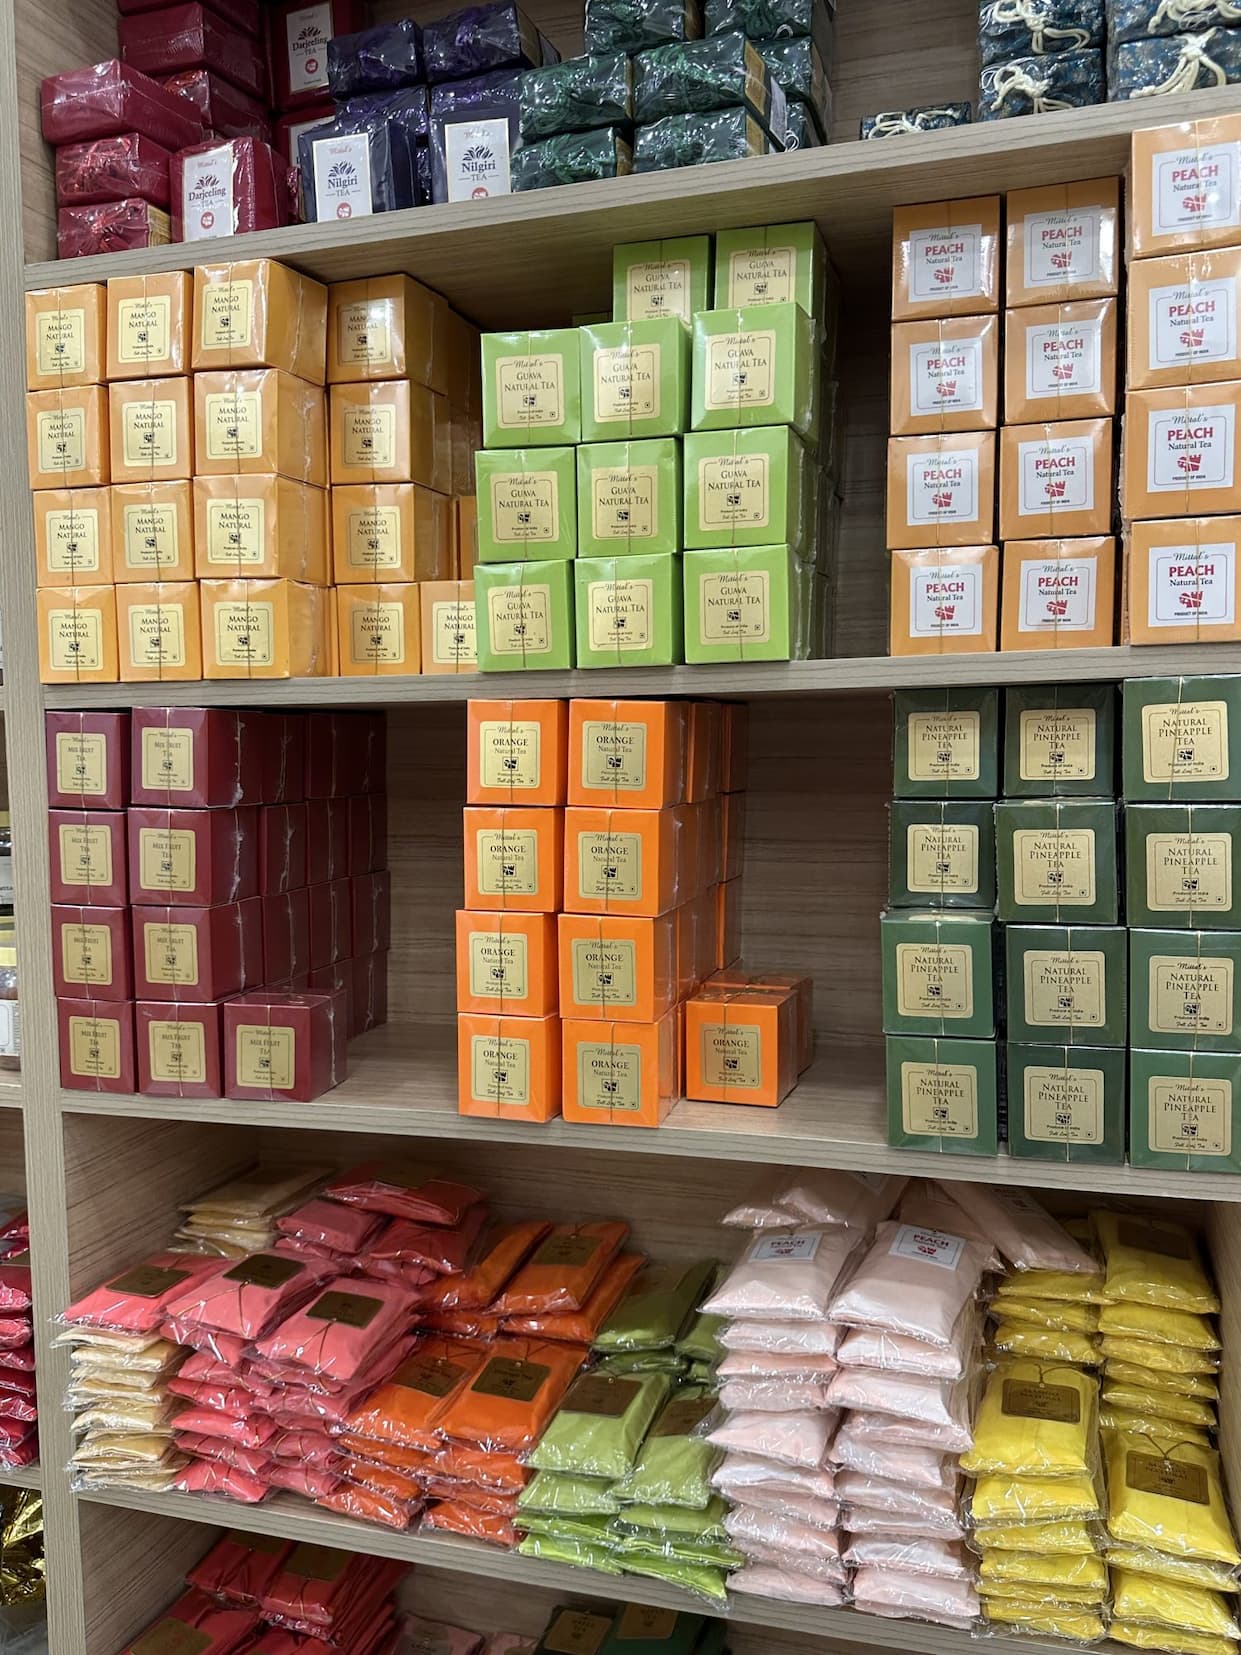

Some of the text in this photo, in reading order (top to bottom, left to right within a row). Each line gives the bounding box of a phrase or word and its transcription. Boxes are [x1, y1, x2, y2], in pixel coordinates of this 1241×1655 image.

[462, 160, 496, 173] Nilgiri
[471, 173, 487, 182] TEA
[1172, 165, 1218, 181] PEACH
[328, 175, 358, 189] Nilgiri
[189, 186, 226, 202] Darjeeling
[1041, 226, 1082, 240] PEACH
[925, 243, 964, 256] PEACH
[926, 255, 963, 264] Natural Tea
[749, 260, 774, 269] GUAVA
[737, 269, 787, 280] NATURAL TEA
[634, 281, 681, 293] NATURAL TEA
[1169, 301, 1215, 316] PEACH
[1201, 314, 1214, 323] Tea
[1043, 338, 1084, 352] PEACH
[1070, 350, 1082, 358] Tea
[752, 358, 767, 367] TEA
[927, 356, 965, 369] PEACH
[517, 371, 541, 381] GUAVA
[928, 368, 964, 377] Natural Tea
[601, 371, 650, 384] NATURAL TEA
[540, 380, 555, 389] TEA
[354, 417, 381, 426] MANGO
[353, 426, 383, 435] NATURAL
[1167, 427, 1213, 441] PEACH
[1168, 440, 1211, 450] Natural Tea
[1035, 457, 1075, 470] PEACH
[721, 469, 747, 479] GUAVA
[923, 469, 962, 480] PEACH
[1037, 469, 1074, 478] Natural Tea
[746, 479, 760, 488] TEA
[924, 479, 961, 489] Natural Tea
[511, 489, 536, 498] GUAVA
[611, 486, 636, 495] GUAVA
[499, 498, 549, 508] NATURAL TEA
[599, 495, 649, 505] NATURAL TEA
[221, 513, 249, 521] MANGO
[137, 518, 163, 526] MANGO
[219, 521, 251, 529] NATURAL
[360, 519, 387, 528] MANGO
[136, 526, 166, 534] NATURAL
[358, 528, 389, 536] NATURAL
[1169, 565, 1214, 577] PEACH
[1038, 576, 1078, 588] PEACH
[1170, 577, 1213, 587] Natural Tea
[720, 586, 747, 596] GUAVA
[926, 582, 965, 593] PEACH
[1038, 587, 1077, 596] Natural Tea
[608, 594, 632, 603] GUAVA
[708, 595, 760, 606] NATURAL TEA
[927, 593, 963, 602] Natural Tea
[507, 602, 531, 610] GUAVA
[596, 604, 645, 614] NATURAL TEA
[229, 615, 258, 624] MANGO
[362, 616, 390, 624] MANGO
[446, 614, 473, 622] MANGO
[496, 611, 544, 620] NATURAL TEA
[227, 624, 260, 632] NATURAL
[361, 624, 391, 633] NATURAL
[444, 623, 475, 632] NATURAL
[59, 630, 90, 638] NATURAL
[1163, 719, 1207, 728] NATURAL
[926, 725, 964, 733] NATURAL
[1037, 724, 1077, 733] NATURAL
[1159, 727, 1212, 737] PINEAPPLE
[596, 736, 634, 744] ORANGE
[922, 733, 968, 741] PINEAPPLE
[1033, 733, 1080, 741] PINEAPPLE
[1177, 737, 1195, 746] TEA
[490, 845, 526, 853] ORANGE
[591, 846, 629, 855] ORANGE
[921, 843, 966, 851] PINEAPPLE
[1034, 842, 1077, 850] NATURAL
[1030, 851, 1081, 859] PINEAPPLE
[1168, 848, 1213, 856] NATURAL
[1047, 860, 1064, 868] TEA
[1164, 857, 1218, 866] PINEAPPLE
[1182, 867, 1200, 875] TEA
[504, 957, 514, 965] Tea
[586, 953, 624, 961] ORANGE
[914, 956, 954, 965] NATURAL
[910, 964, 958, 973] PINEAPPLE
[1044, 967, 1087, 975] NATURAL
[927, 974, 943, 982] TEA
[1040, 975, 1092, 984] PINEAPPLE
[1170, 973, 1214, 982] NATURAL
[1057, 984, 1075, 993] TEA
[1166, 982, 1219, 992] PINEAPPLE
[1183, 991, 1201, 1000] TEA
[713, 1038, 750, 1048] ORANGE
[483, 1050, 518, 1060] ORANGE
[591, 1060, 630, 1070] ORANGE
[920, 1079, 960, 1088] NATURAL
[916, 1088, 965, 1097] PINEAPPLE
[1042, 1084, 1084, 1093] NATURAL
[933, 1096, 949, 1105] TEA
[1038, 1093, 1089, 1102] PINEAPPLE
[1168, 1095, 1212, 1103] NATURAL
[1055, 1102, 1072, 1110] TEA
[1164, 1103, 1217, 1113] PINEAPPLE
[913, 1233, 949, 1248] PEACH
